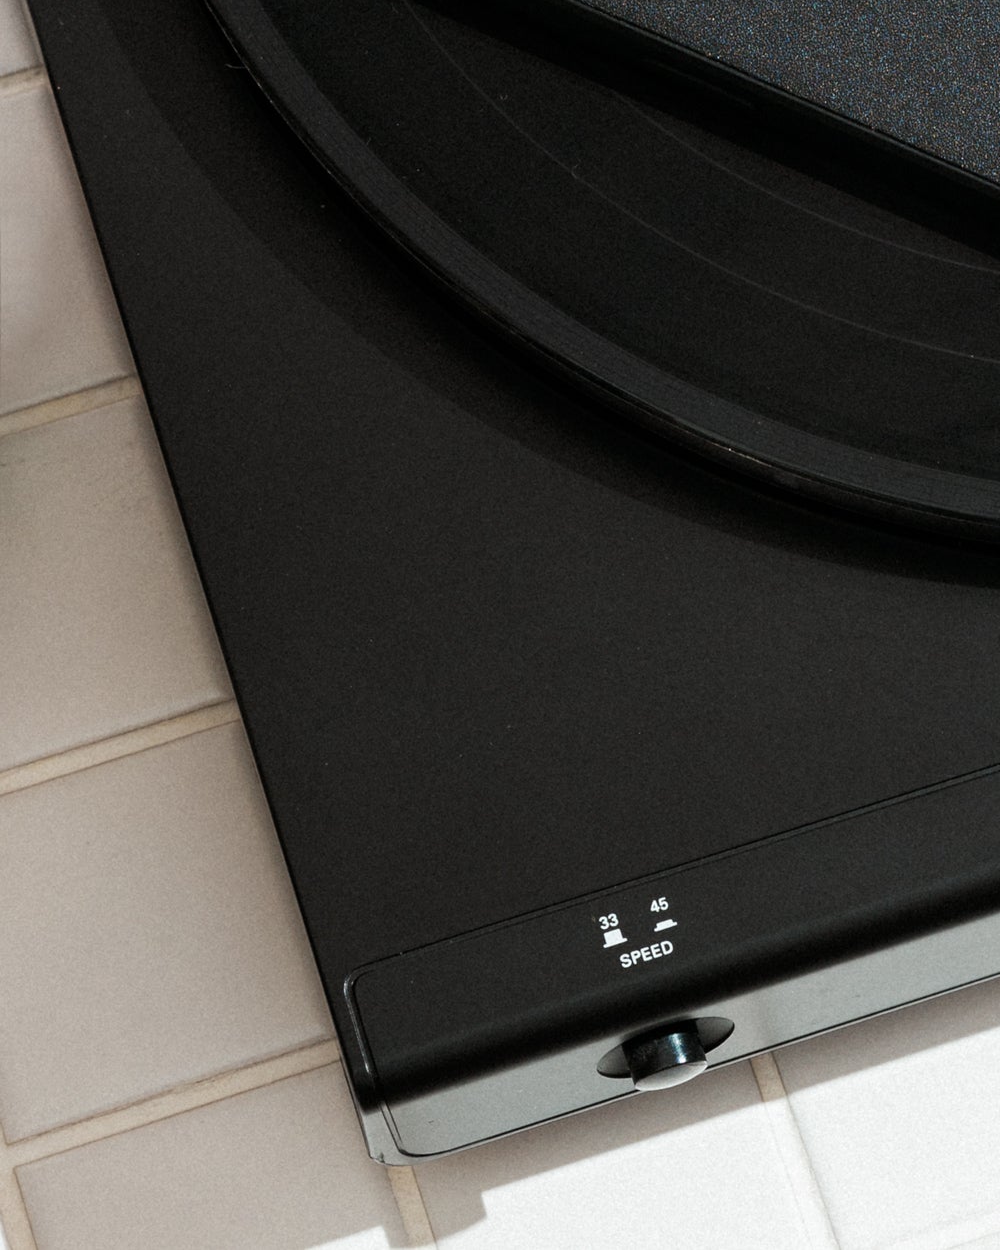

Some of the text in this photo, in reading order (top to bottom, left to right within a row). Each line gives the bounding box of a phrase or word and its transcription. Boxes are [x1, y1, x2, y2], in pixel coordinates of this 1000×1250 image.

[598, 897, 669, 930] 33 45
[619, 940, 674, 968] SPEED
